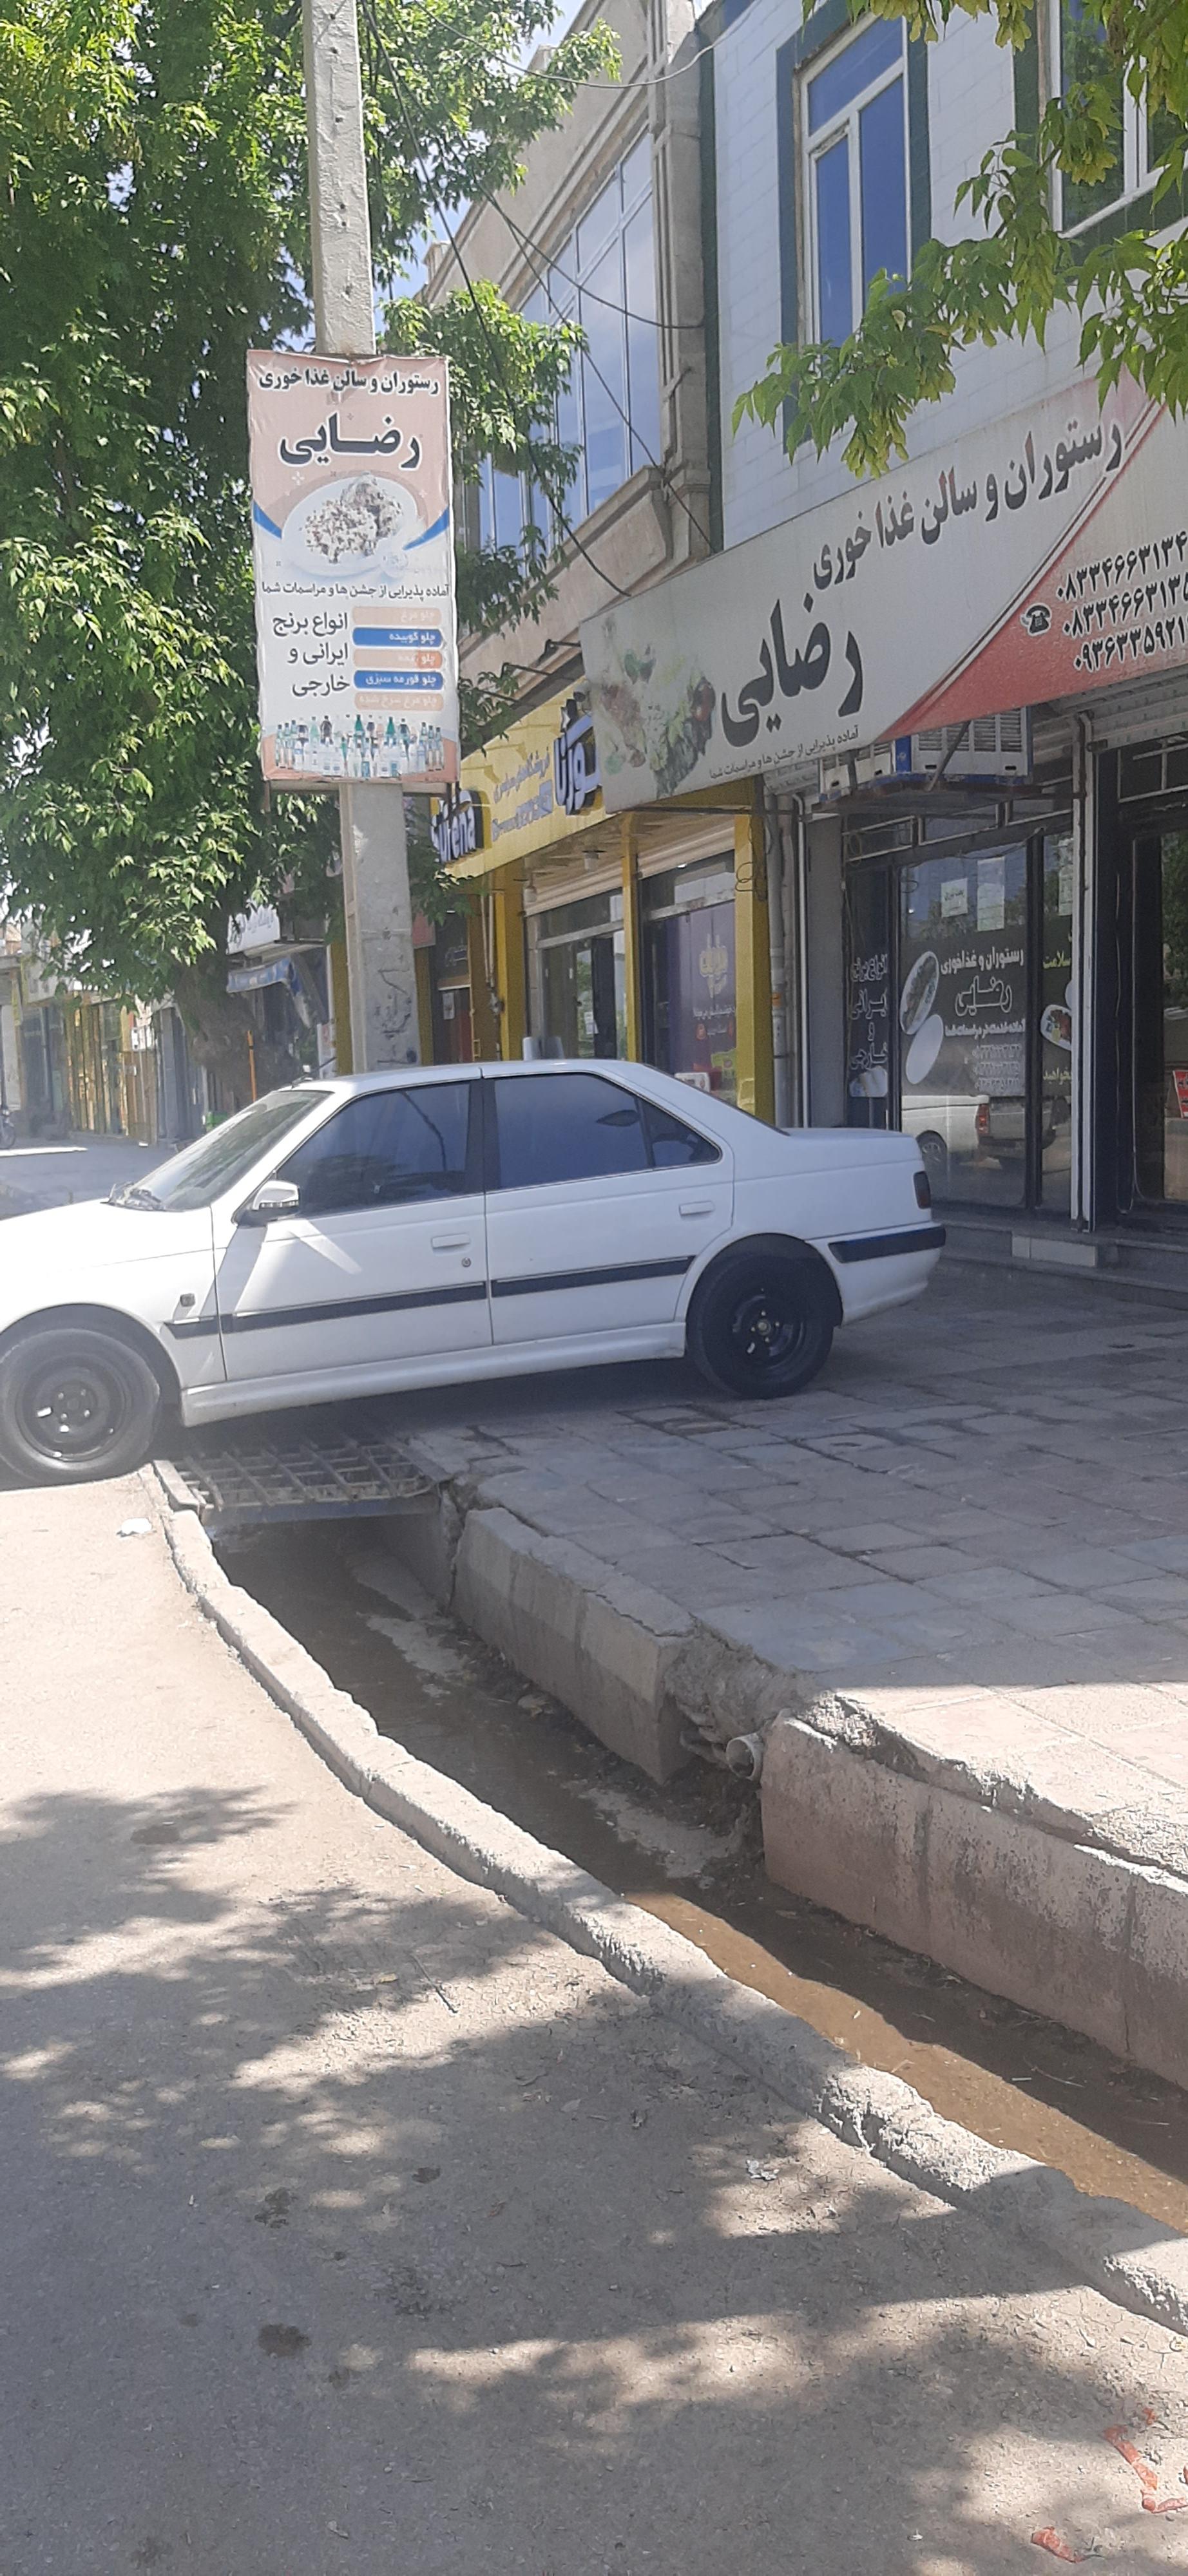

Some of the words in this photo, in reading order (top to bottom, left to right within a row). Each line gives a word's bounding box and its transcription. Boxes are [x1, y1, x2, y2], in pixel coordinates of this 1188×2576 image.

[259, 368, 302, 390] خوری
[305, 368, 329, 386] غذا
[333, 369, 367, 392] سالن
[369, 377, 378, 393] و
[381, 371, 439, 395] رستوران
[280, 412, 421, 469] رضایی
[1004, 420, 1122, 510] رستوران
[921, 466, 977, 545] سالن
[985, 473, 999, 522] و
[875, 490, 914, 549] غذا
[813, 511, 872, 591] خوری
[1057, 531, 1187, 601] ۰۸۳۳۴۶۶۳۱۳۴
[262, 582, 280, 593] شما
[283, 582, 326, 597] مراسمات
[329, 586, 334, 596] و
[335, 583, 348, 595] ها
[349, 584, 376, 598] جشن
[379, 585, 387, 598] از
[388, 584, 423, 601] پذیرایی
[426, 583, 449, 597] آماده
[273, 612, 309, 636] برنج
[312, 612, 348, 636] انواع
[421, 632, 436, 645] چلو
[1075, 616, 1188, 670] ۰۹۳۶۳۳۵۹۲۱
[287, 648, 298, 663] و
[303, 643, 349, 666] ایرانی
[421, 654, 436, 665] چلو
[722, 592, 863, 748] رضایی
[292, 674, 350, 697] خارجی
[365, 673, 391, 685] سبزی
[422, 675, 437, 687] چلو
[837, 725, 858, 744] آماده
[797, 743, 803, 758] از
[805, 734, 836, 755] پذیرایی
[757, 759, 762, 770] و
[762, 753, 772, 764] ها
[774, 748, 795, 764] جشن
[709, 768, 723, 779] شما
[725, 759, 756, 774] مراسمات
[978, 955, 984, 971] و
[986, 947, 1024, 970] رستوران
[955, 975, 1012, 1017] رضایی
